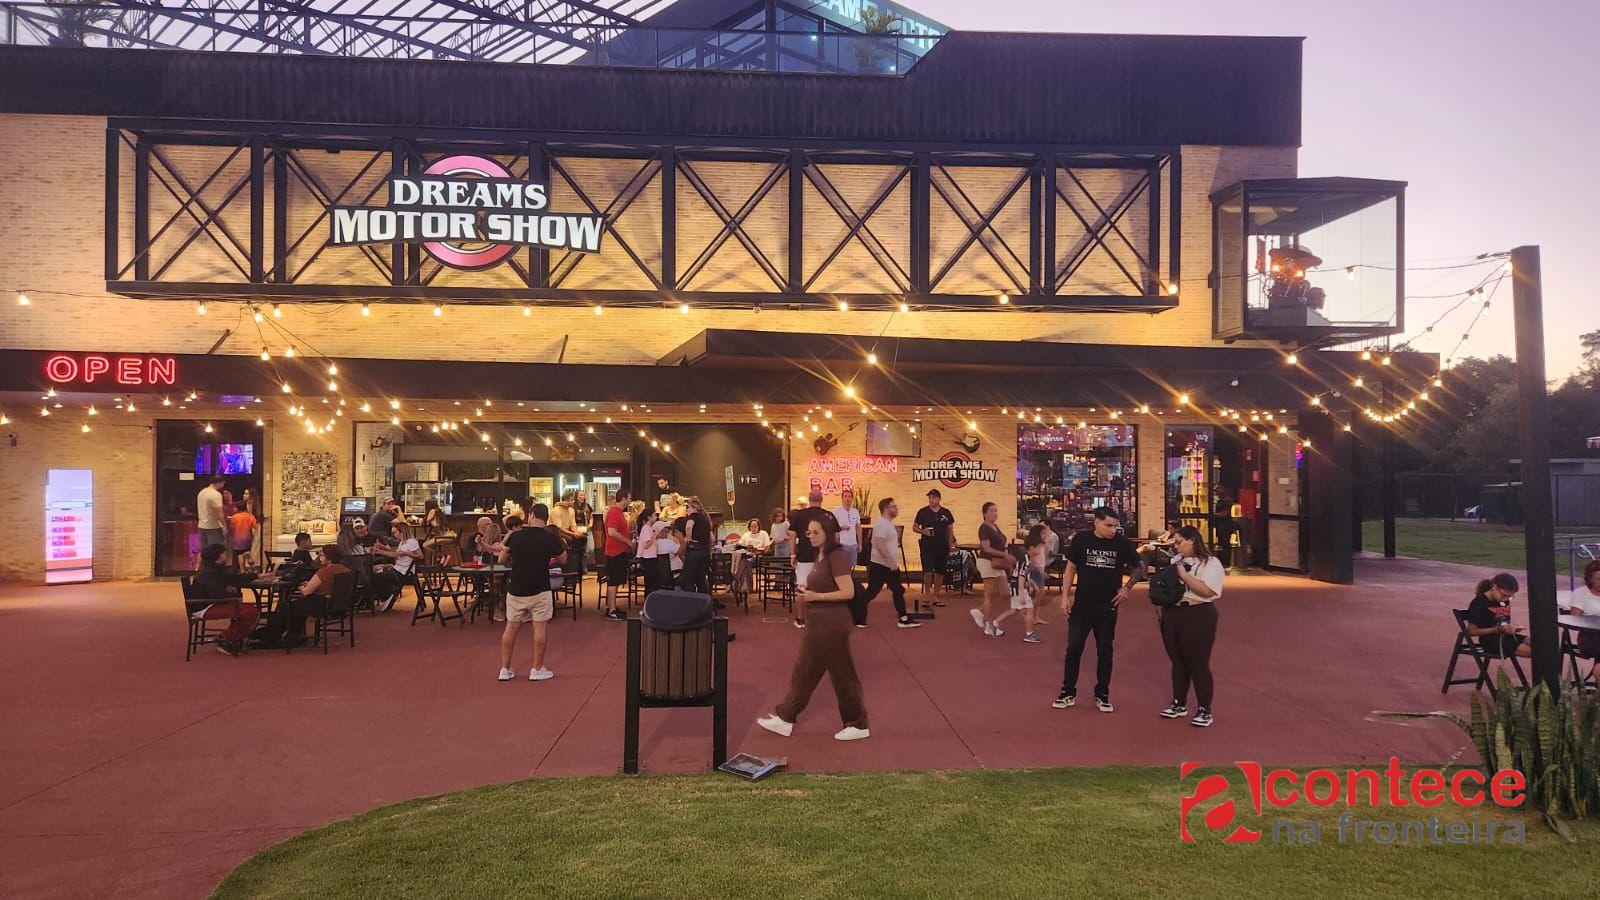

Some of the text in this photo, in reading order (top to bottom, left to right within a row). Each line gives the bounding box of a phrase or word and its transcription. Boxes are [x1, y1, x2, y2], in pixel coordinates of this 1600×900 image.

[393, 179, 547, 210] DREAMS
[333, 209, 603, 251] MOTOR SHOW
[46, 355, 176, 385] OPEN
[808, 457, 898, 473] AMERICAN
[931, 460, 980, 470] DREAMS
[914, 469, 996, 482] MOTOR SHOW
[809, 476, 856, 495] BAR
[1086, 548, 1118, 558] LACOSTE
